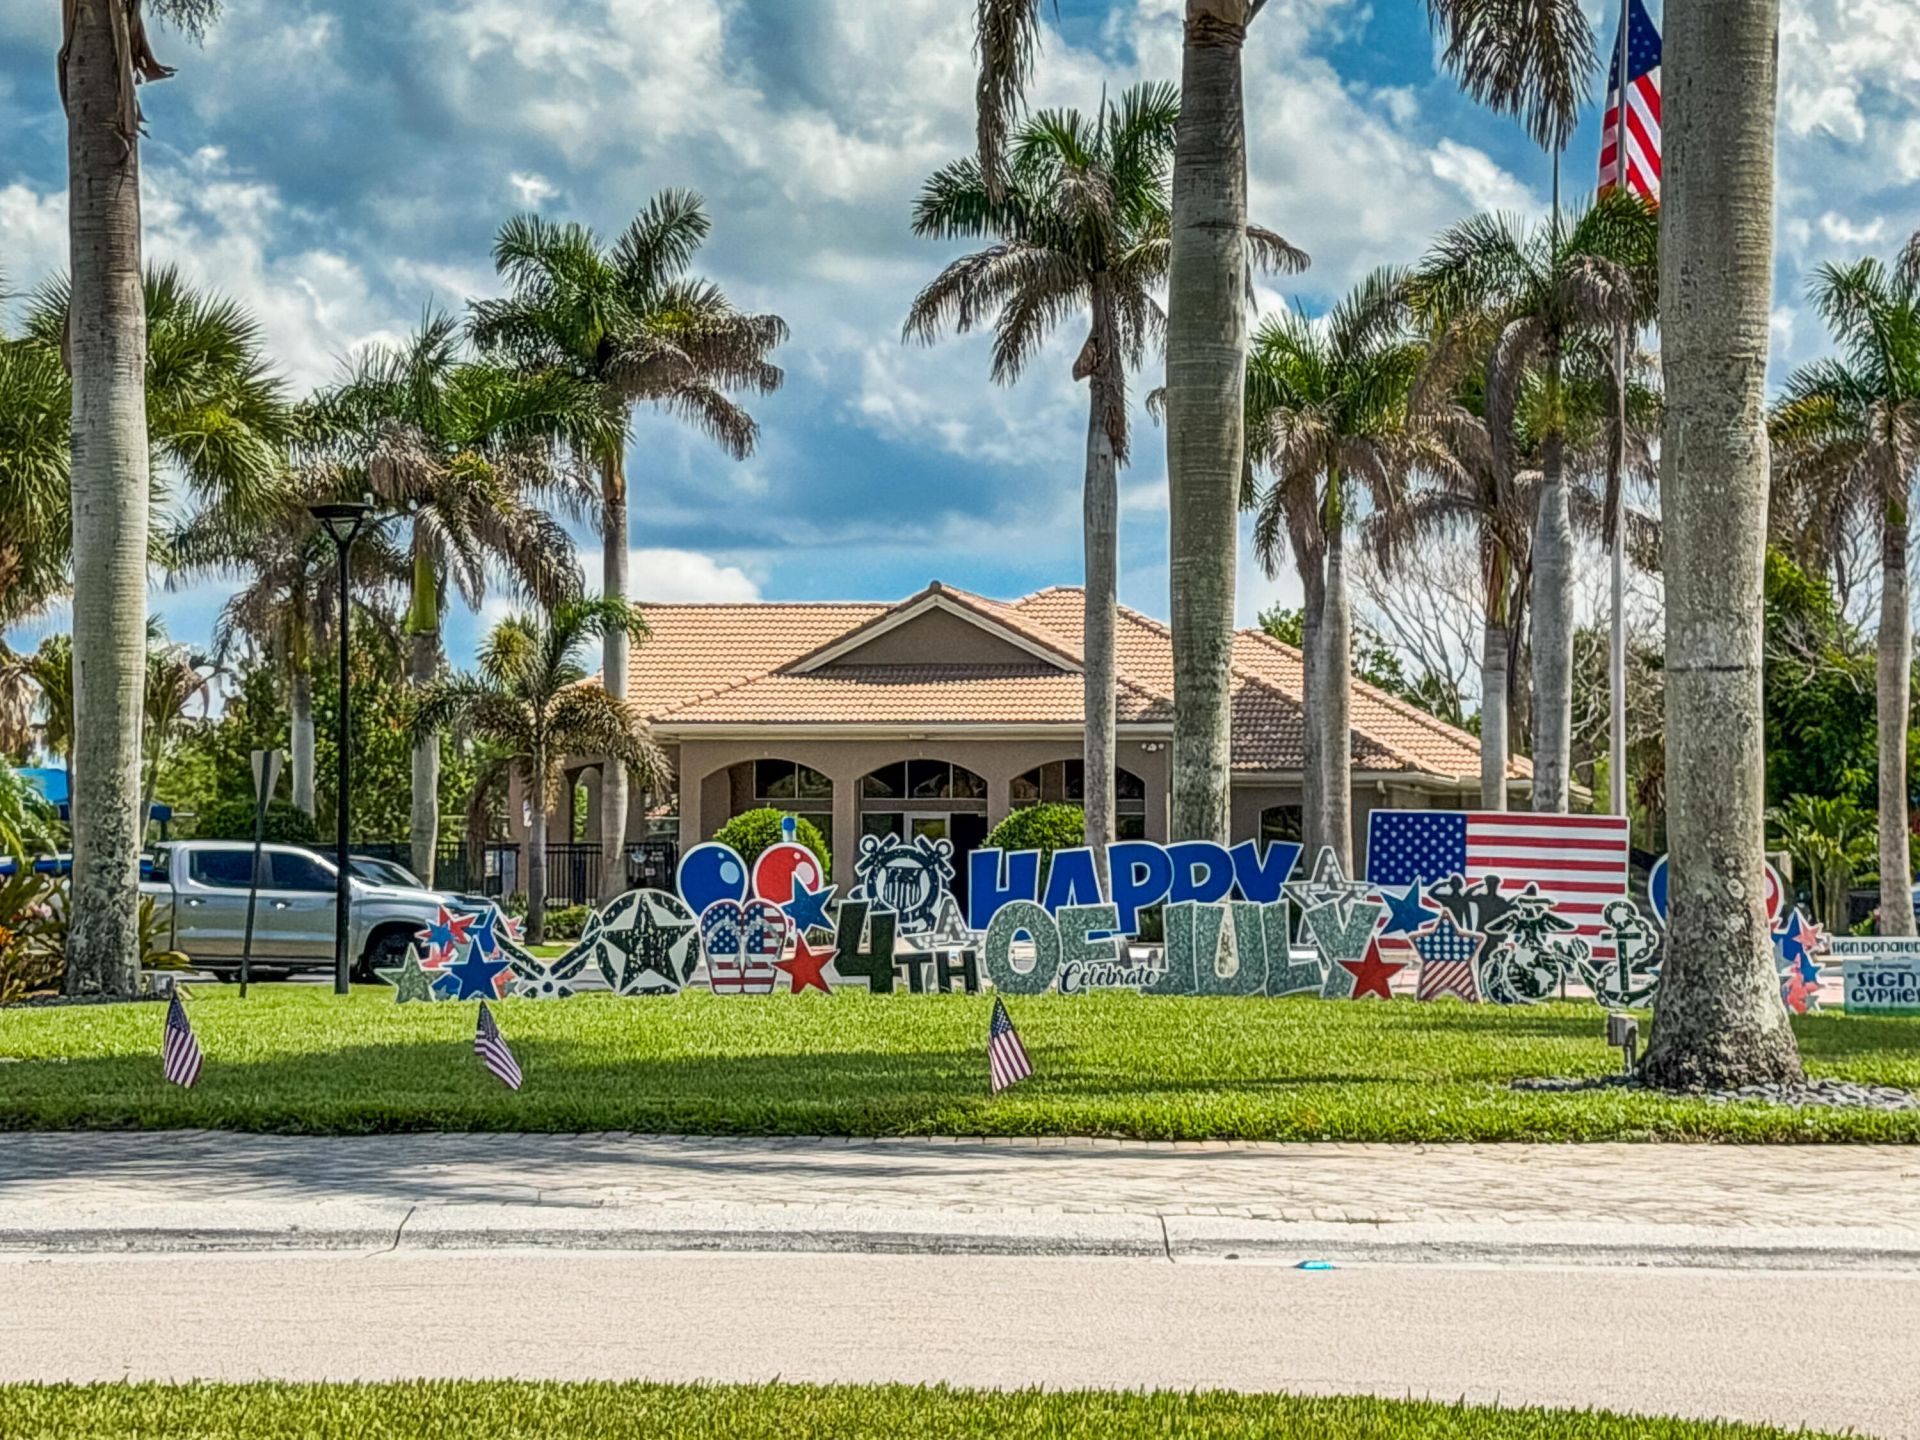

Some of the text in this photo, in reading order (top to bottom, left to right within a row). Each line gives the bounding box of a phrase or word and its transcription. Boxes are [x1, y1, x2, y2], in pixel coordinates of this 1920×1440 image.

[969, 839, 1303, 936] HAPPY
[834, 899, 1385, 997] 4TH OF JULY
[1059, 961, 1155, 993] Celebrate
